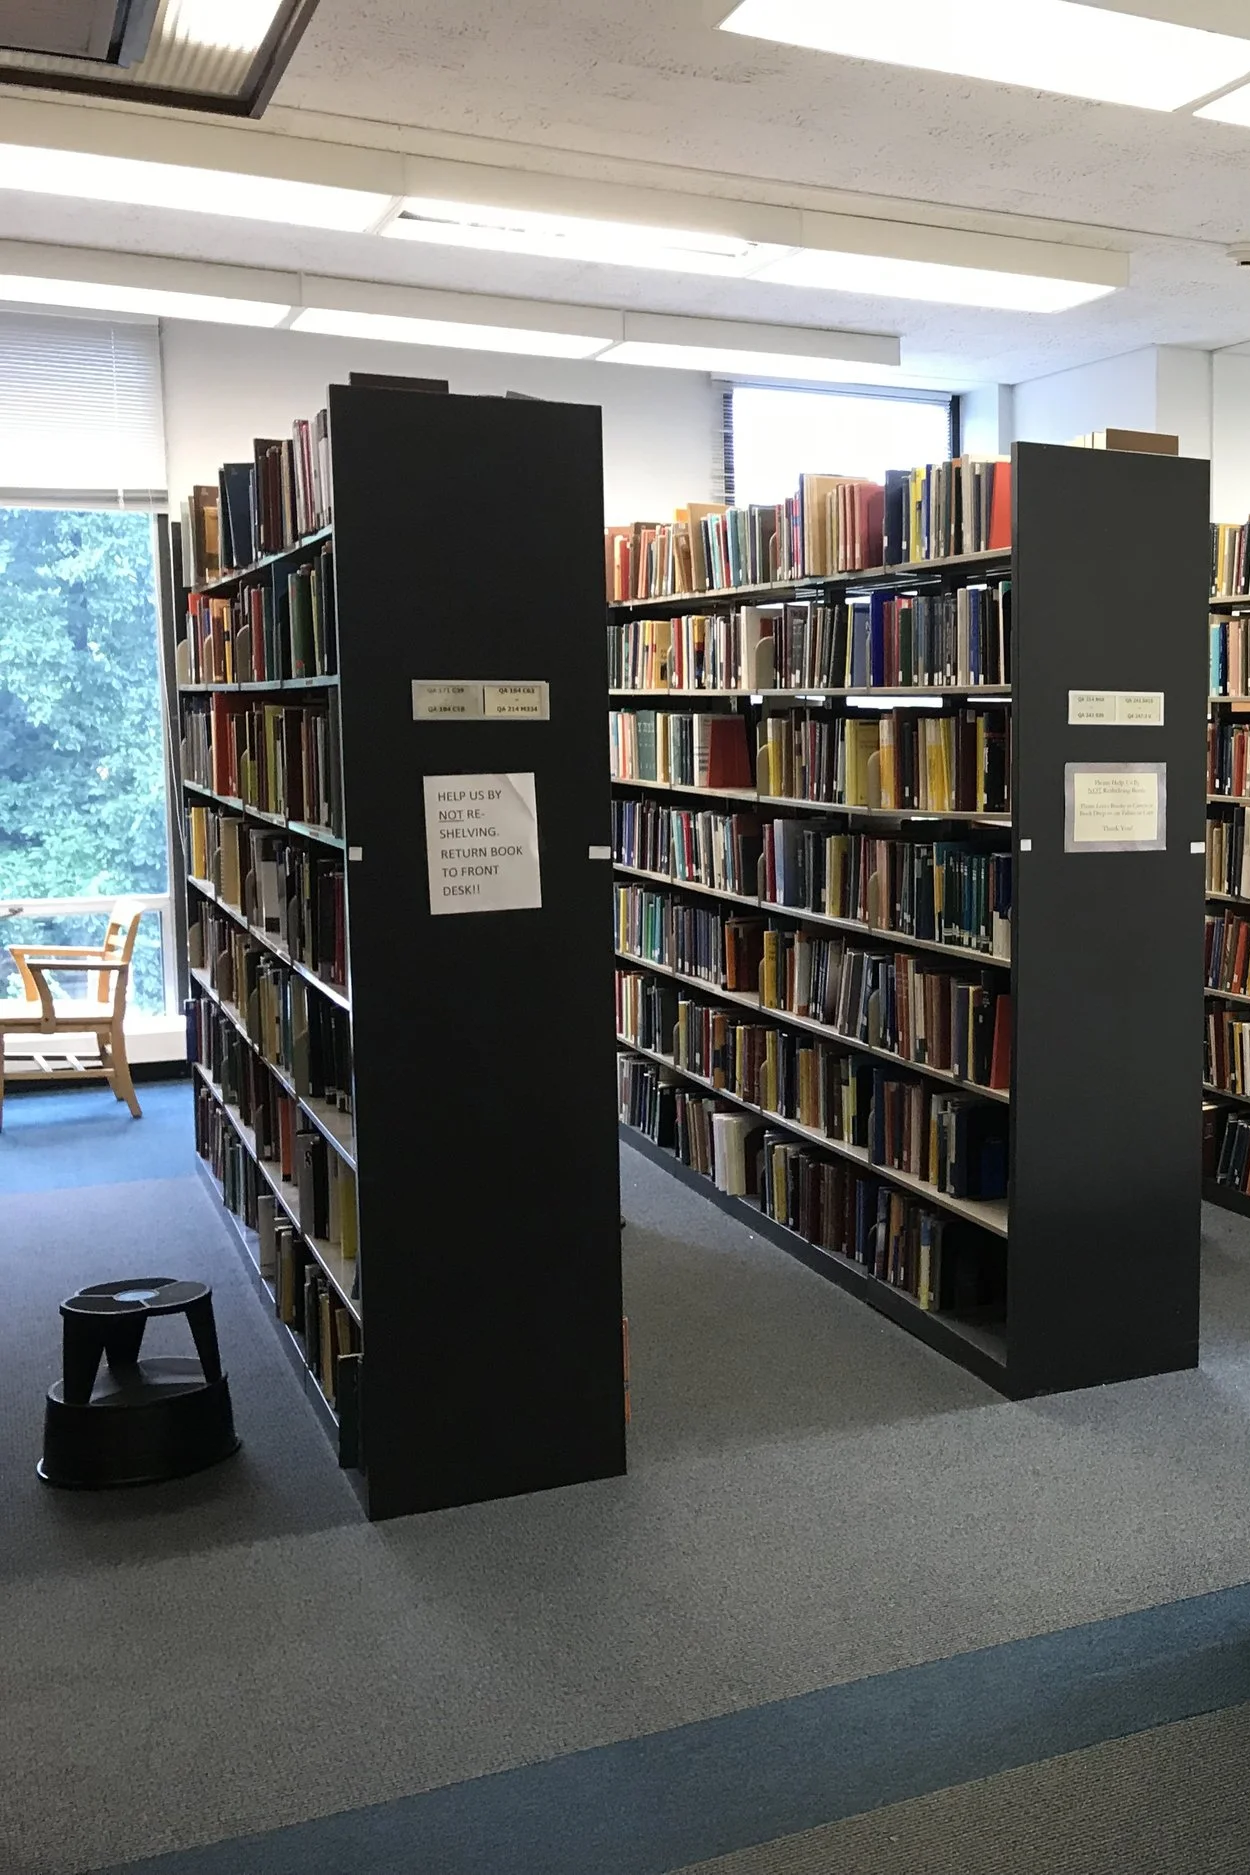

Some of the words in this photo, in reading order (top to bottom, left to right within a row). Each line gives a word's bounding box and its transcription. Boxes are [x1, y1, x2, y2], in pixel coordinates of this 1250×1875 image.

[437, 790, 466, 802] HELP
[469, 790, 485, 801] US
[487, 789, 502, 800] BY
[438, 809, 464, 821] NOT
[467, 809, 485, 820] RE-
[439, 826, 500, 840] SHELVING.
[441, 847, 487, 860] RETURN
[490, 845, 523, 858] BOOK
[442, 867, 458, 878] TO
[461, 865, 499, 877] FRONT
[443, 884, 480, 897] DESK!!
